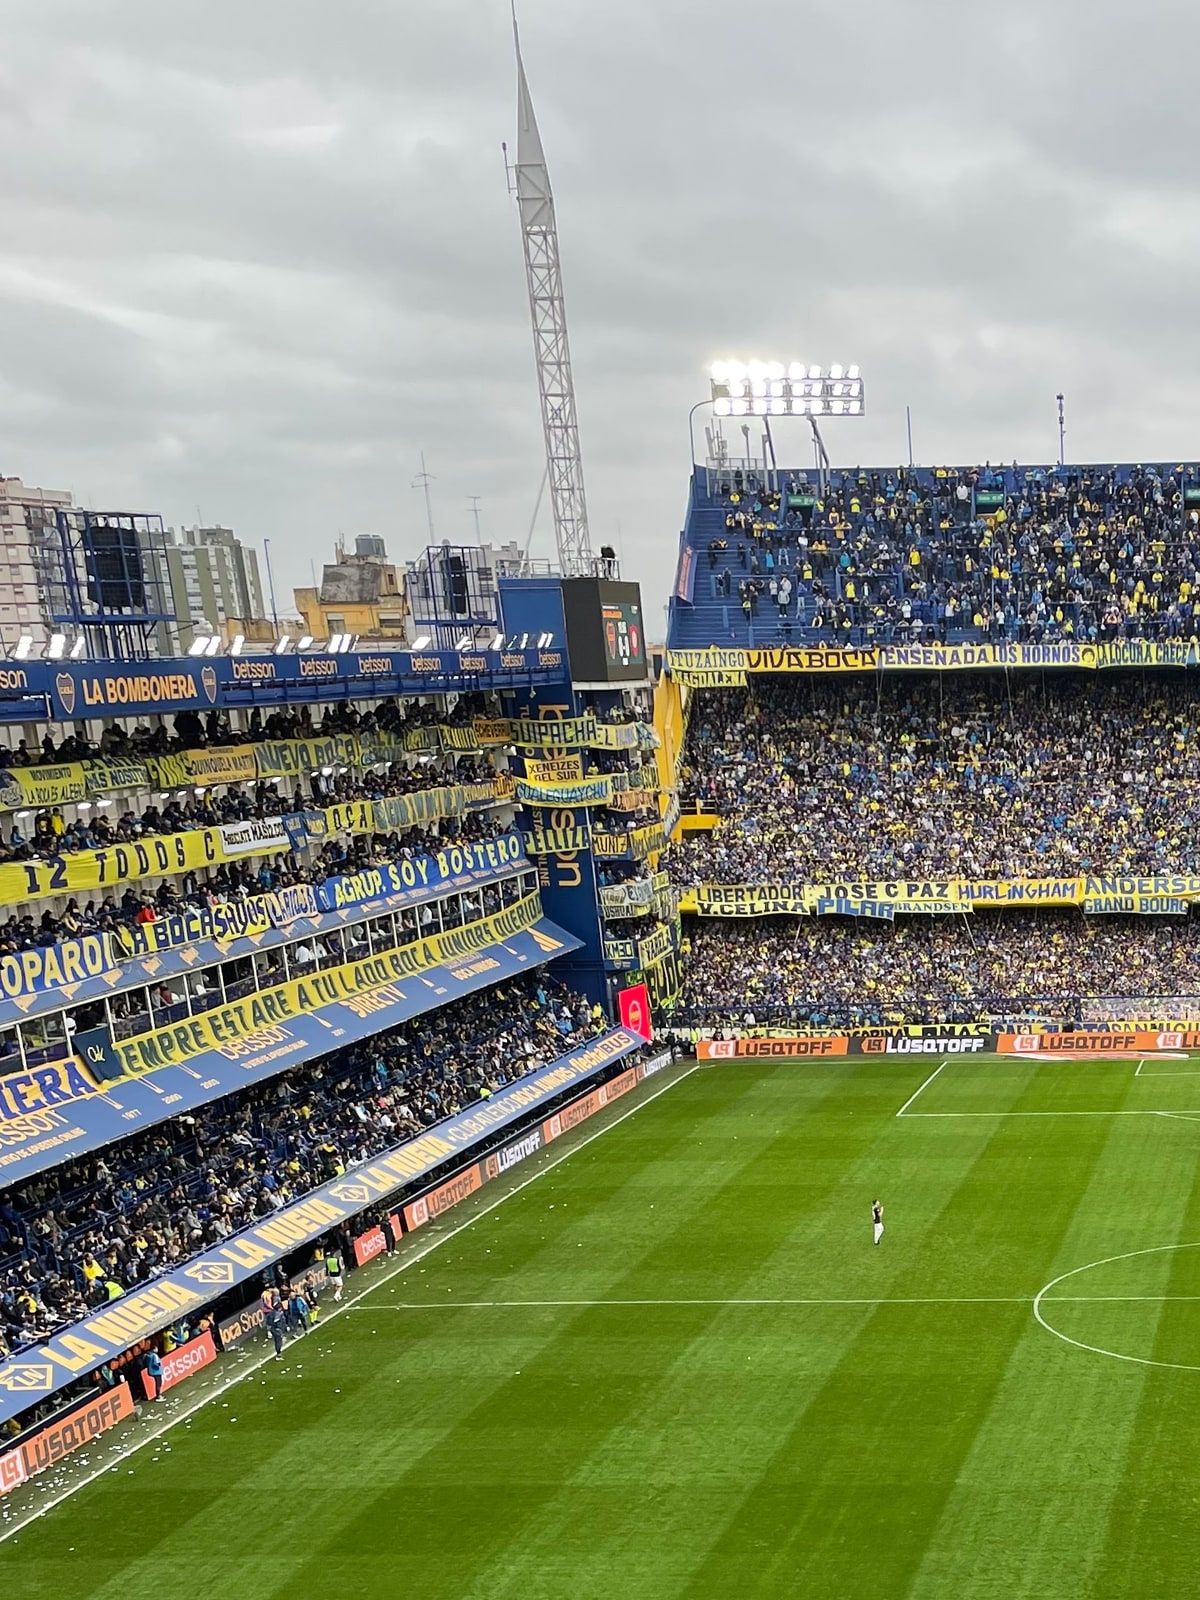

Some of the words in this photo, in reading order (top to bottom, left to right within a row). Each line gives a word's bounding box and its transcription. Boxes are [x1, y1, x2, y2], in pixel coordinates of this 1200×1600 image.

[410, 654, 441, 672] betsson
[459, 653, 487, 670] betsson
[501, 652, 525, 668] betsson
[538, 651, 562, 665] betsson
[669, 649, 745, 668] ITUZAINGO
[747, 650, 800, 668] VIVA
[807, 650, 877, 668] BOCA
[884, 648, 988, 667] ENSENADA
[1021, 645, 1080, 664] HORNOS
[1109, 644, 1152, 665] LOCURA
[1155, 642, 1188, 664] CRECE
[231, 658, 276, 680] betsson
[299, 657, 338, 676] betsson
[358, 656, 392, 674] betsson
[82, 678, 104, 706] LA
[105, 674, 198, 704] BOMBONERA
[510, 719, 597, 745] SUIPACHA
[256, 738, 311, 773] NUEVO
[315, 736, 358, 763] BOCA
[528, 760, 580, 775] XENEIZES
[556, 770, 578, 782] SUR
[24, 857, 68, 895] 12
[95, 836, 187, 883] TODOS
[335, 869, 387, 906] AGRUP.
[388, 857, 430, 892] SOY
[436, 834, 520, 878] BOSTERO
[697, 885, 805, 903] LIBERTADOR
[819, 883, 878, 900] JOSE
[884, 882, 899, 898] C
[906, 882, 949, 898] PAZ
[819, 898, 895, 918] PILAR
[894, 900, 971, 912] BRANDSEN
[1084, 896, 1134, 914] GRAND
[1138, 898, 1189, 914] BOURG
[155, 907, 213, 950] BOCA
[208, 988, 293, 1042] ESTARE
[297, 981, 315, 1010] A
[314, 974, 342, 1004] TU
[342, 958, 393, 995] LADO
[392, 941, 438, 974] BOCA
[437, 921, 495, 964] JUNIORS
[734, 1040, 832, 1056] LÜSQTOFF
[885, 1036, 985, 1053] LÜSQTOFF
[1039, 1033, 1136, 1050] LÜSQTOFF
[449, 1118, 481, 1142] CLUB
[513, 1081, 545, 1112] BOCA
[534, 1066, 577, 1091] JUNIORS
[497, 1131, 541, 1172] LÜSQTOFF
[356, 1163, 400, 1192] LA
[381, 1134, 457, 1179] NUEVA
[426, 1172, 474, 1216] LÜSQTOFF
[225, 1235, 276, 1270] LA
[254, 1198, 346, 1250] NUEVA
[361, 1232, 388, 1256] betss
[47, 1333, 109, 1372] LA
[91, 1282, 199, 1346] NUEVA
[241, 1309, 265, 1335] Shop
[22, 1395, 122, 1477] LÜSQTOFF
